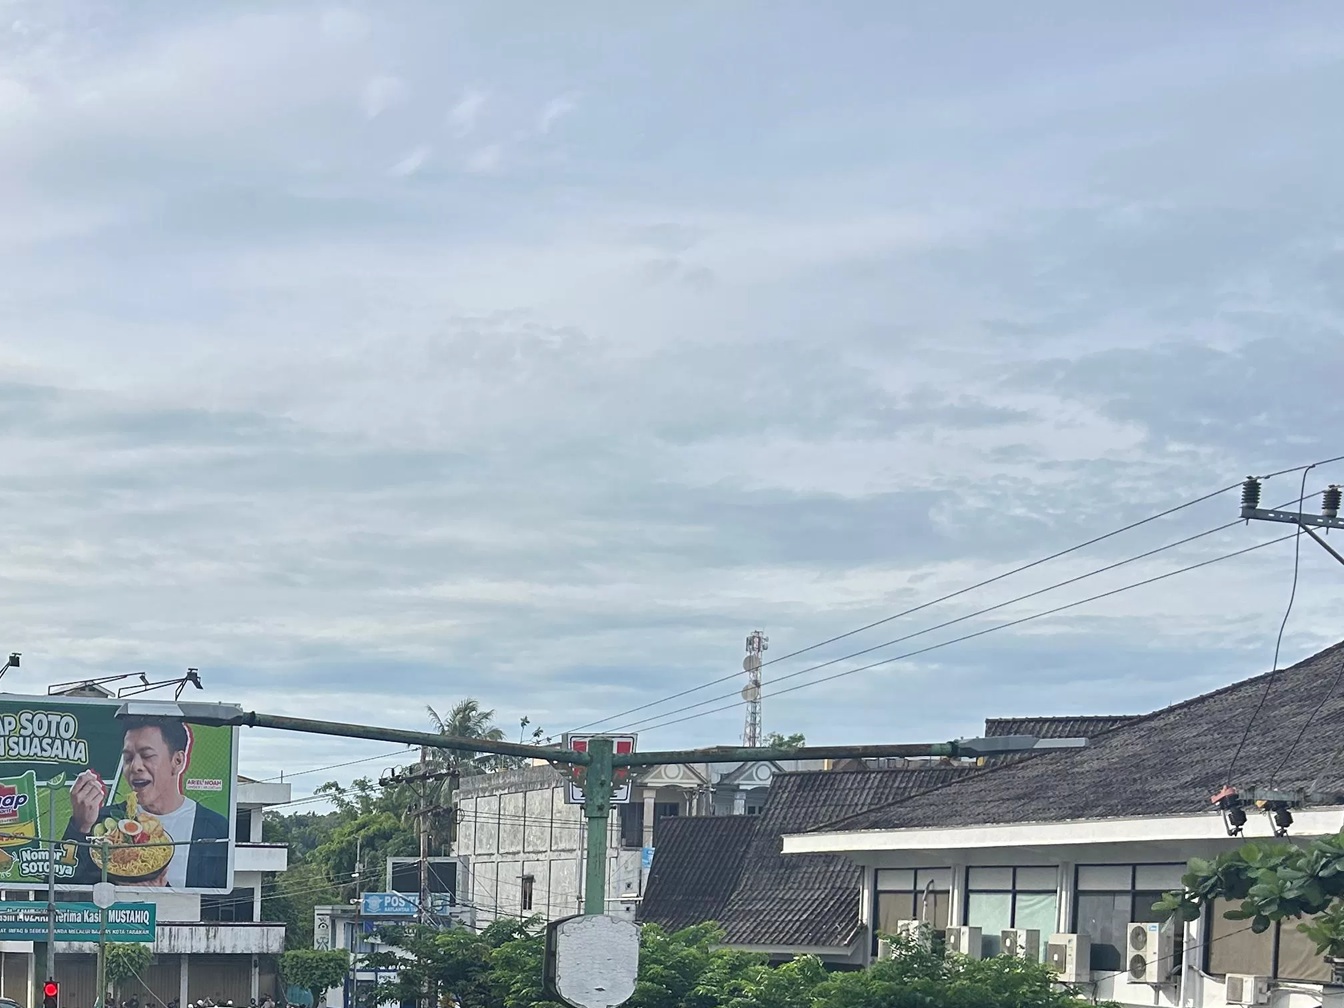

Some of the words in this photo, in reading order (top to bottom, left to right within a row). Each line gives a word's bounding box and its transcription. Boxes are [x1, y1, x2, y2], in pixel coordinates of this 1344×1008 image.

[19, 712, 76, 739] SOTO
[6, 735, 86, 762] SUASANA
[384, 896, 404, 907] POS
[108, 910, 150, 925] MUSTAHIQ
